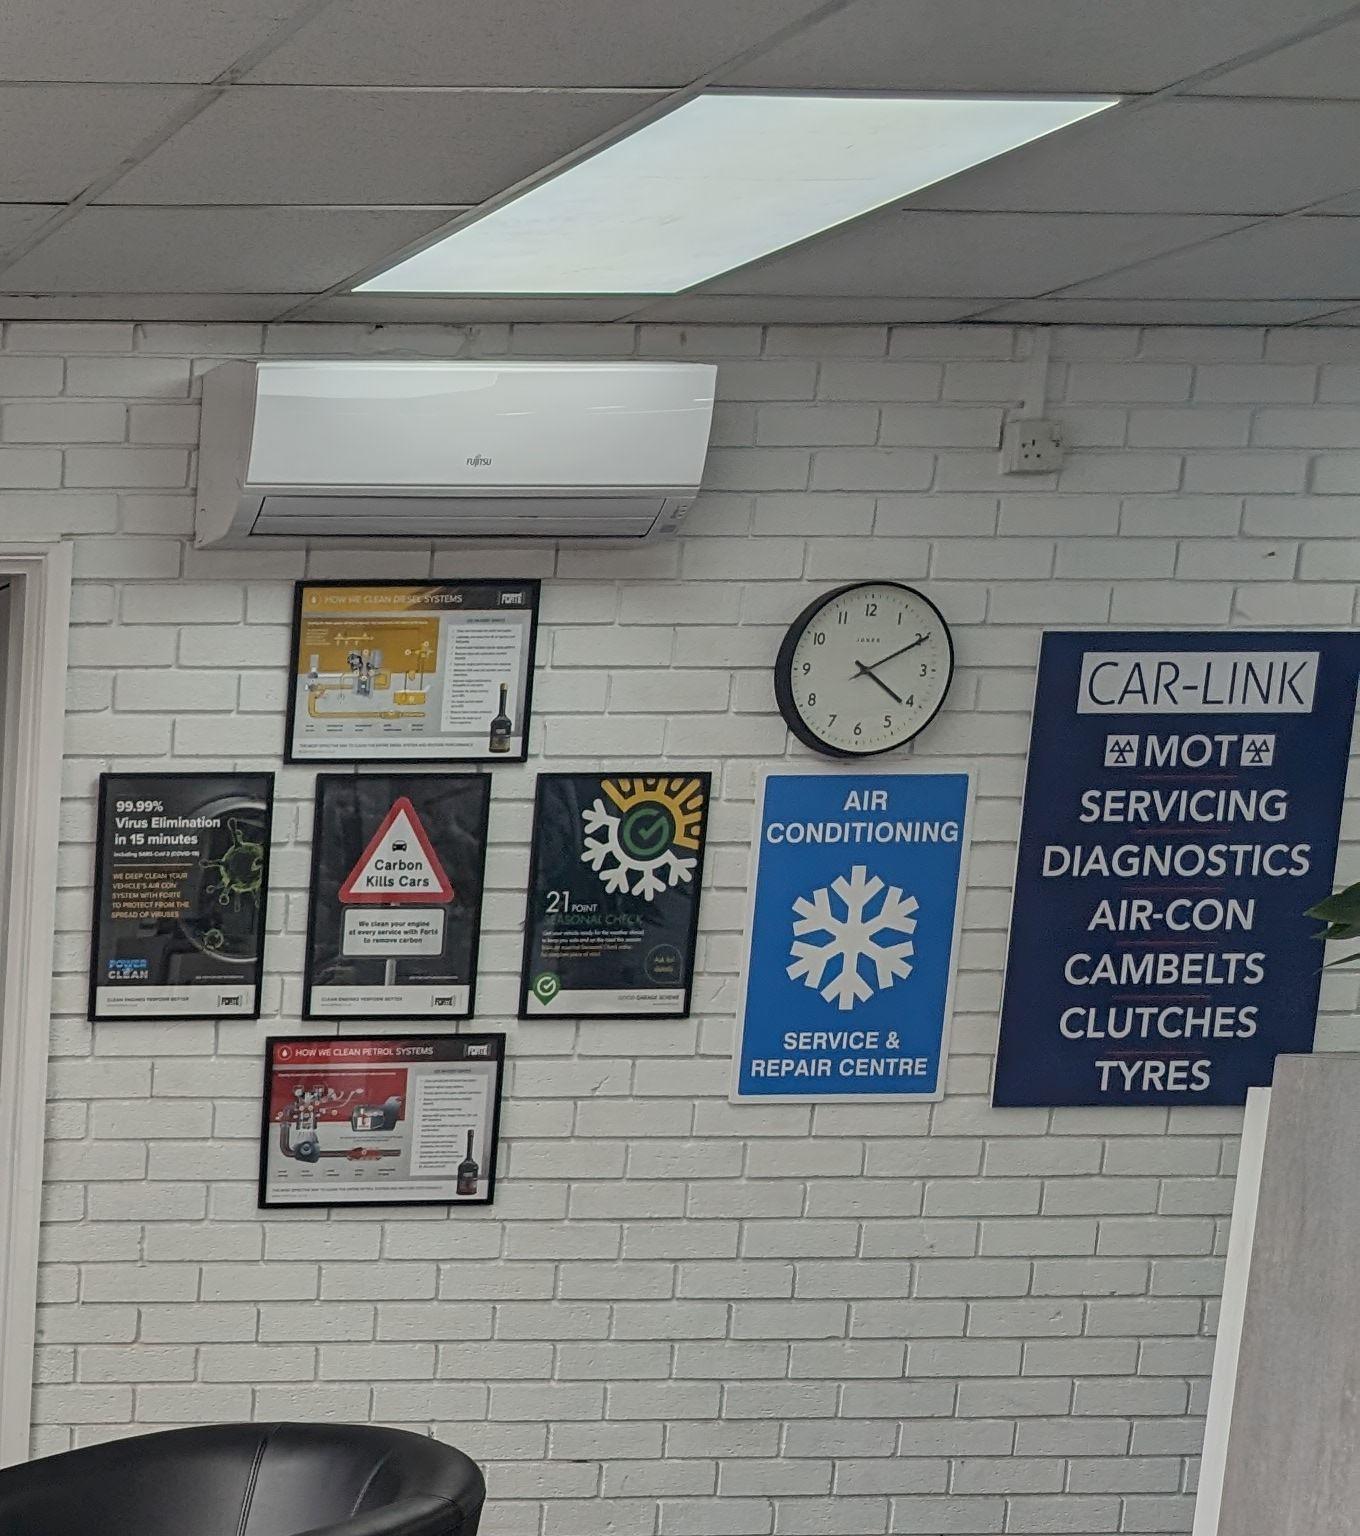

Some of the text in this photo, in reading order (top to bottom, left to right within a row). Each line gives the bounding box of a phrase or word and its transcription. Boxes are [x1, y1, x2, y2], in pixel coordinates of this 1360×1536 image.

[364, 594, 391, 604] CLEAN
[424, 594, 463, 604] SYSTEMS
[865, 604, 877, 617] 12
[838, 611, 848, 624] 11
[897, 612, 902, 625] 1
[813, 633, 826, 645] 10
[802, 663, 811, 675] 9
[920, 664, 927, 677] 3
[1087, 659, 1311, 706] CAR-LINK
[807, 693, 817, 706] 8
[905, 695, 914, 707] 4
[828, 714, 837, 727] 7
[883, 715, 891, 728] 5
[853, 722, 862, 735] 6
[1143, 734, 1239, 767] MOT
[116, 801, 164, 813] 99.99%
[843, 791, 888, 811] AIR
[1079, 788, 1289, 824] SERVICING
[116, 816, 221, 829] Virus Elimination
[766, 821, 959, 843] CONDITIONING
[115, 833, 198, 845] in 15 minutes
[374, 859, 423, 871] Carbon
[1042, 844, 1311, 878] DIAGNOSTICS
[365, 875, 430, 887] Kills Cars
[545, 890, 598, 913] 21 POINT
[1088, 899, 1256, 931] AIR-CON
[108, 970, 149, 980] CLEAN
[1064, 952, 1265, 985] CAMBELTS
[1059, 1006, 1258, 1039] CLUTCHES
[783, 1031, 900, 1050] SERVICE &
[295, 1049, 317, 1057] HOW
[333, 1048, 361, 1057] CLEAN
[362, 1048, 394, 1056] PETROL
[395, 1046, 434, 1056] SYSTEMS
[751, 1057, 928, 1078] REPAIR CENTRE
[1094, 1059, 1212, 1092] TYRES
